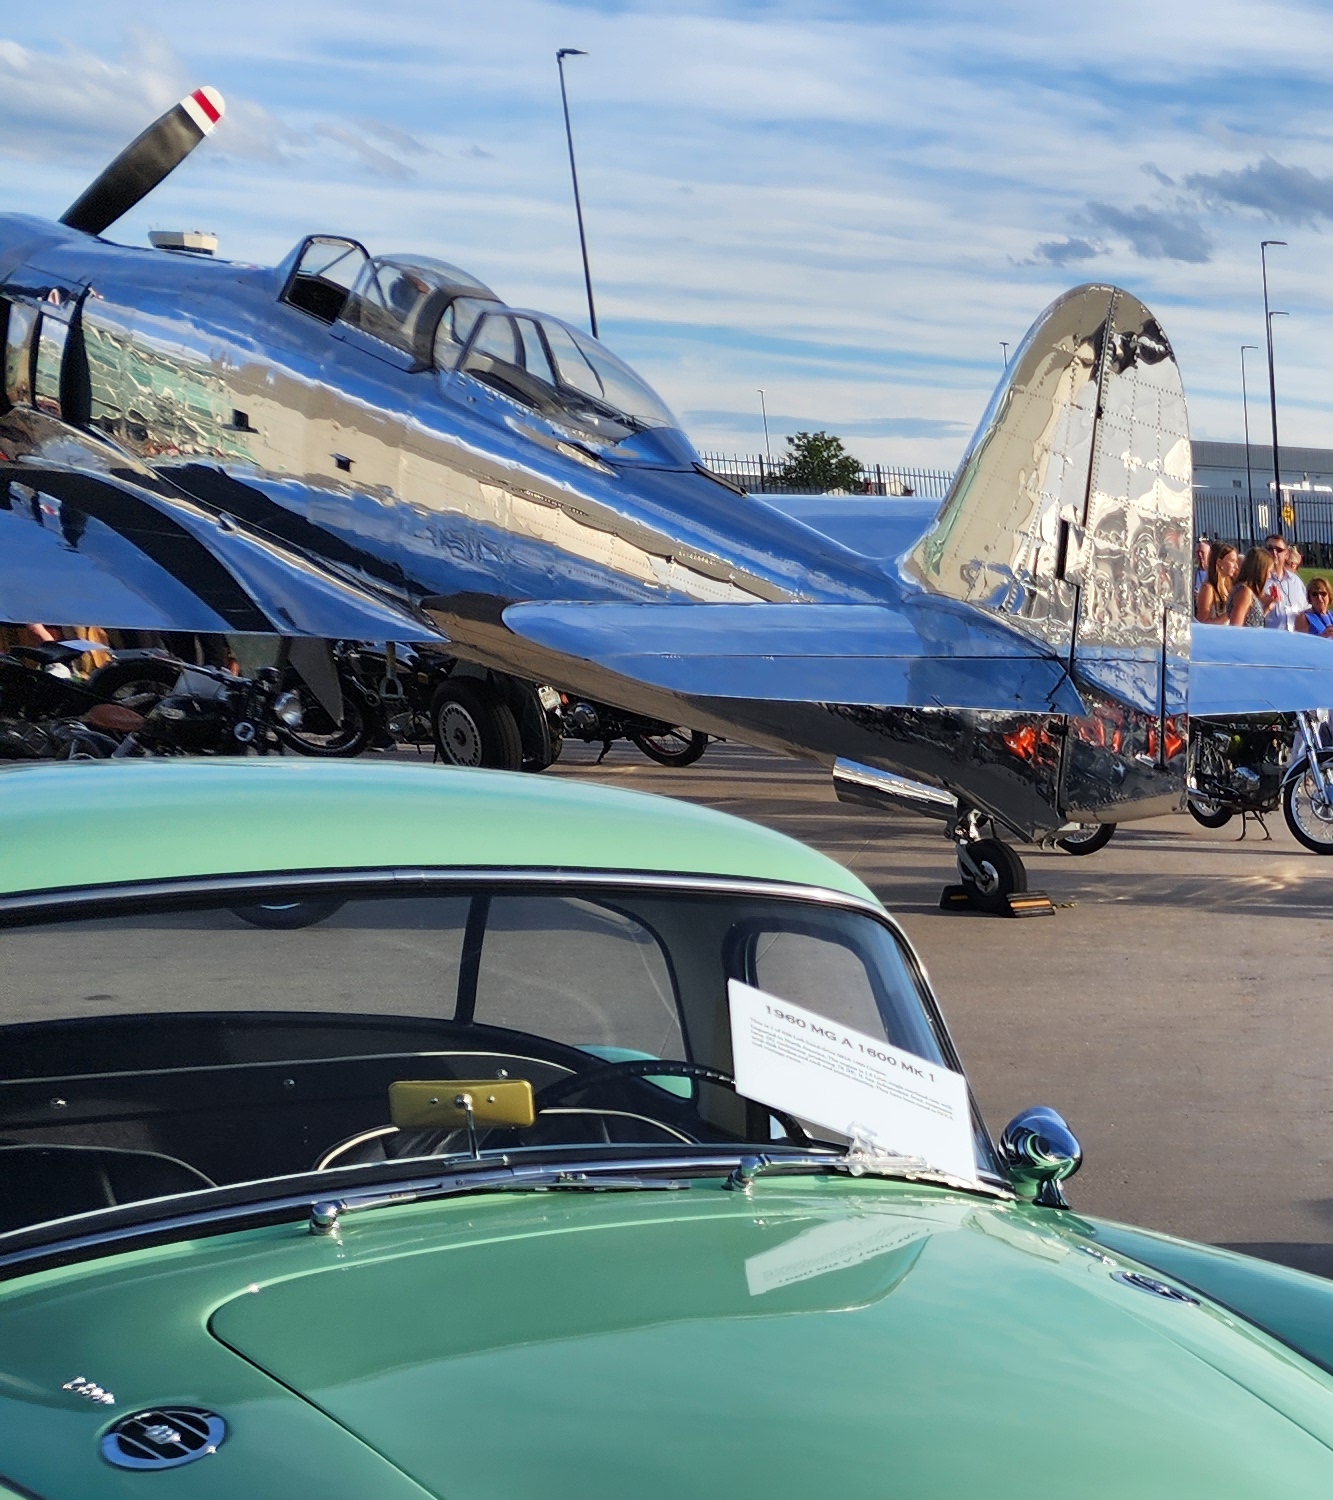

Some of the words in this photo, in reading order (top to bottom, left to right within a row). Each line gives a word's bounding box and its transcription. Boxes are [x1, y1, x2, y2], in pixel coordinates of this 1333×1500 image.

[765, 1005, 806, 1028] 1960
[810, 1023, 837, 1042] MG
[841, 1037, 854, 1049] A
[859, 1044, 897, 1066] 1600
[929, 1072, 936, 1083] 1
